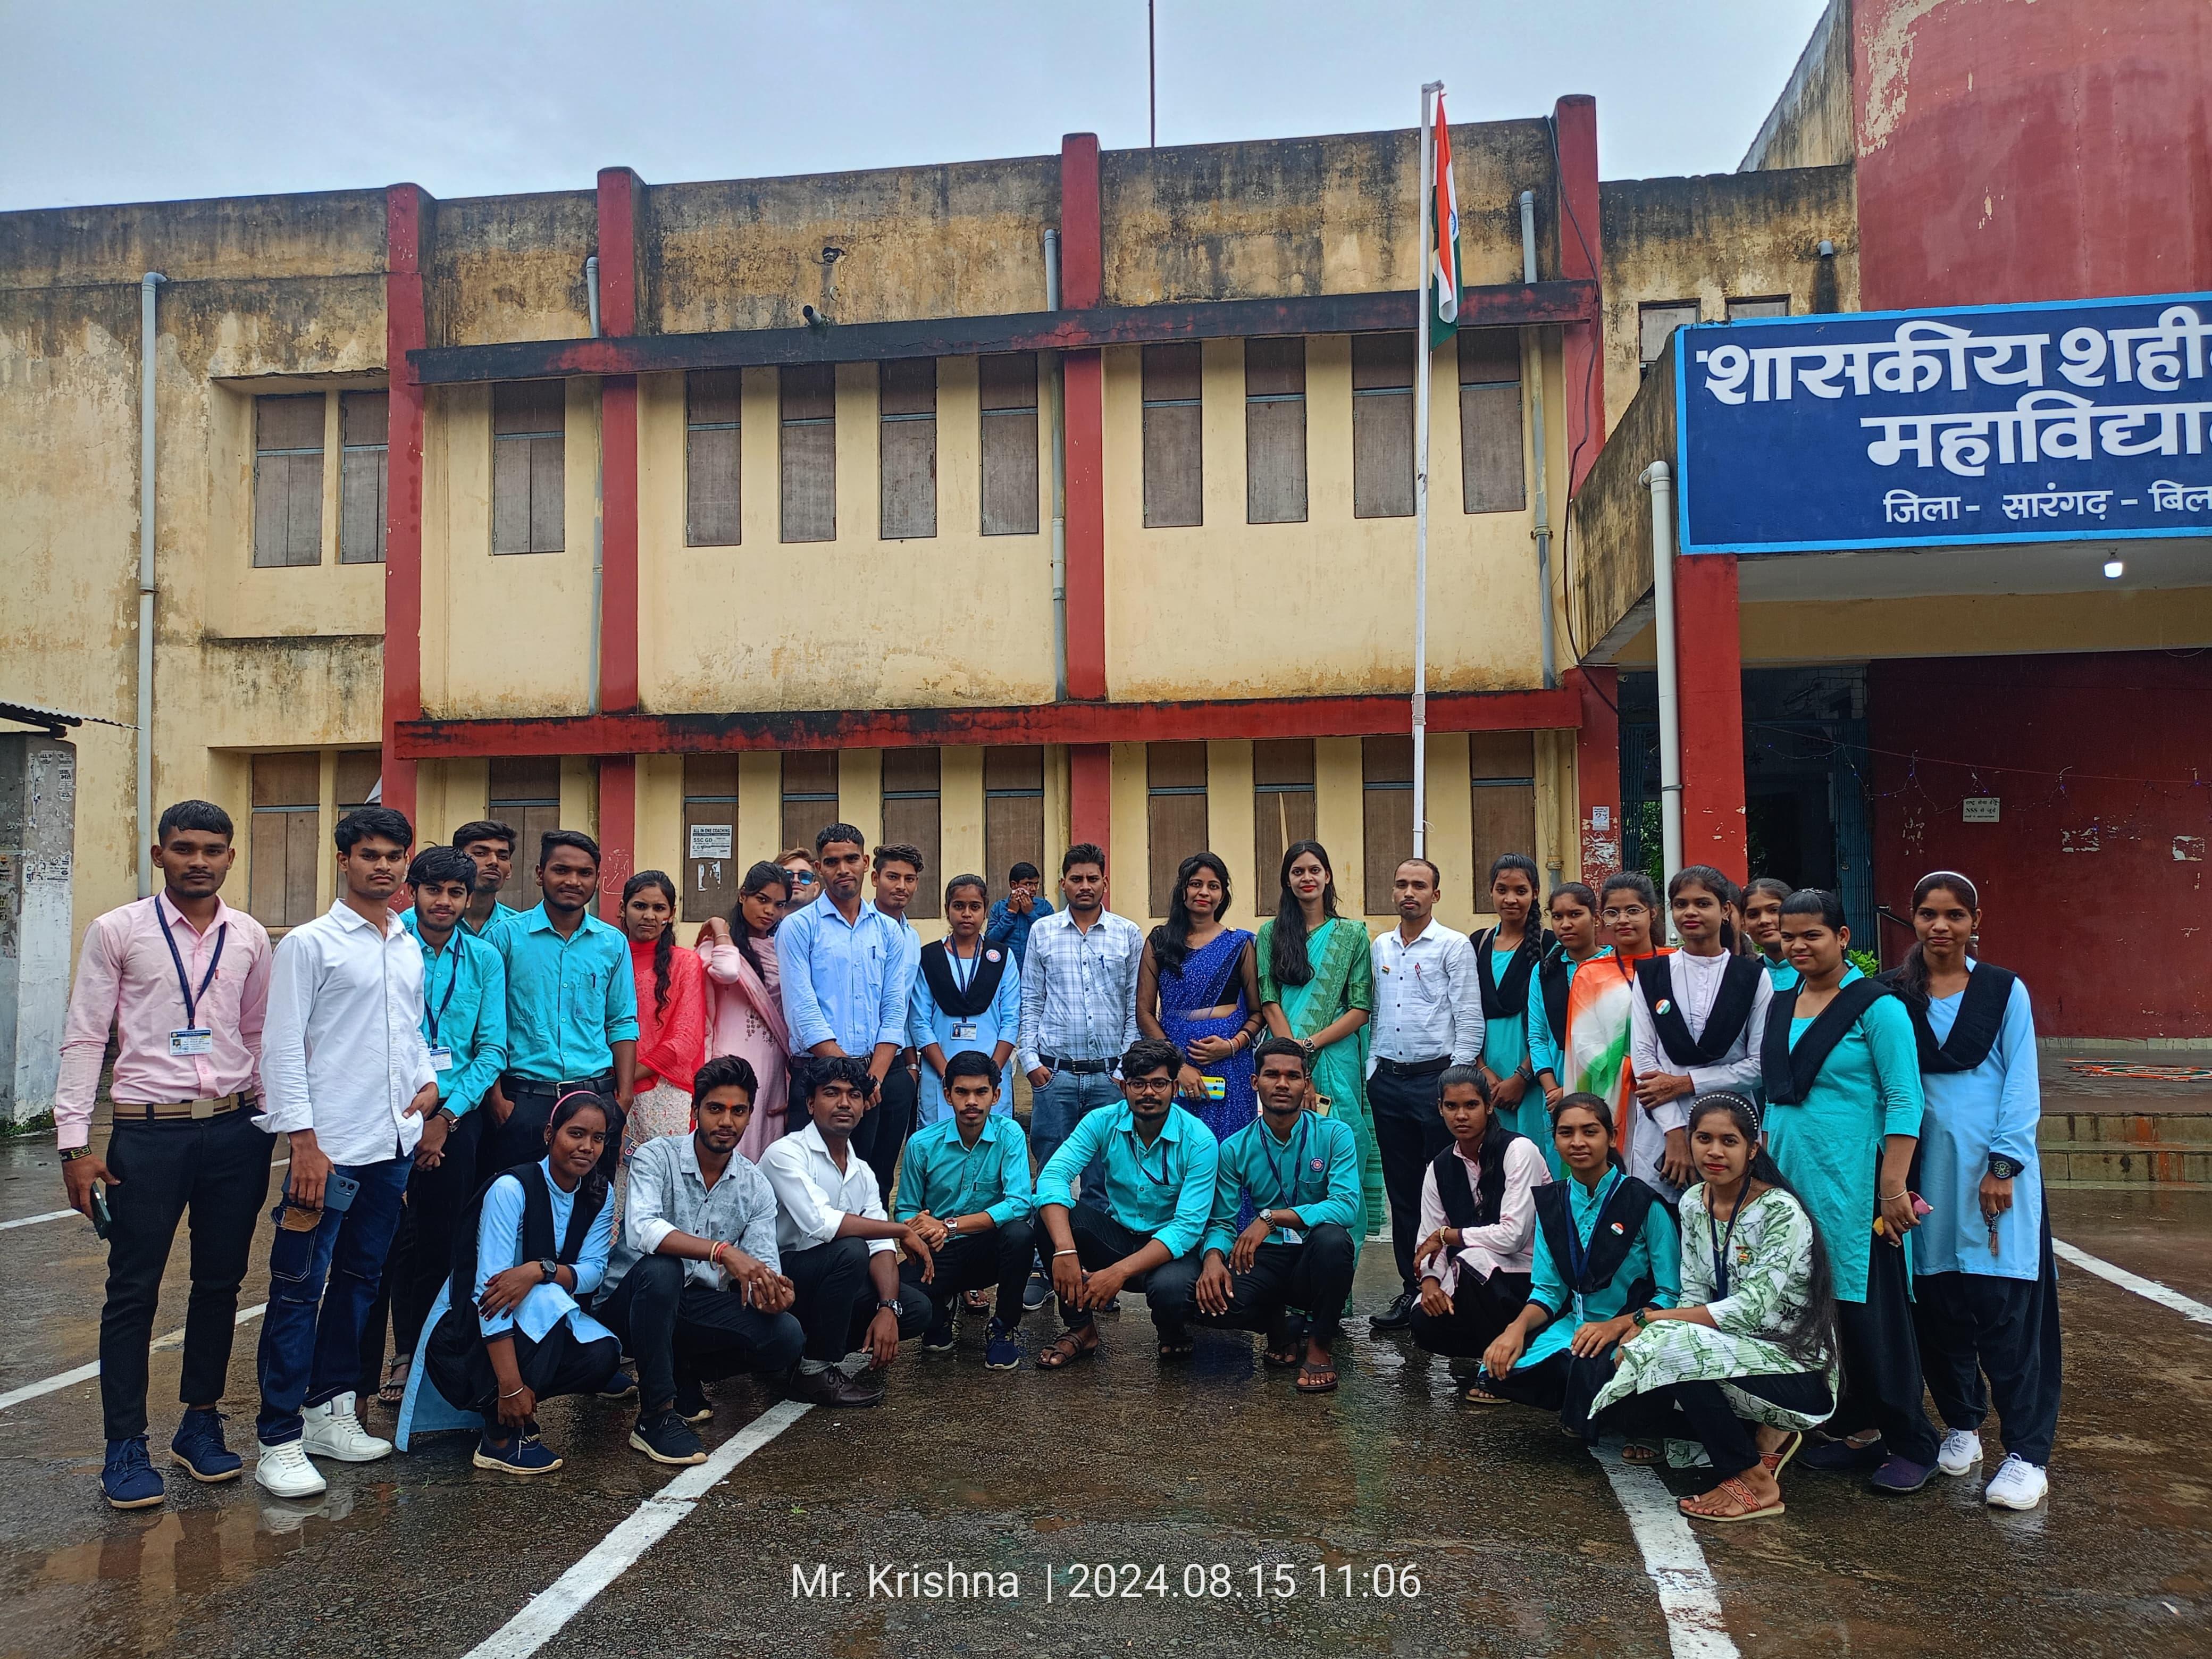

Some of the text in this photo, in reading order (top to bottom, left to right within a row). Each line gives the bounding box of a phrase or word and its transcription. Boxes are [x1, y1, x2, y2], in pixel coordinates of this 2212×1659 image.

[1696, 305, 2212, 405] शासकीय शही
[1860, 389, 2212, 477] महाविद्या
[2002, 482, 2113, 521] सारंगढ़
